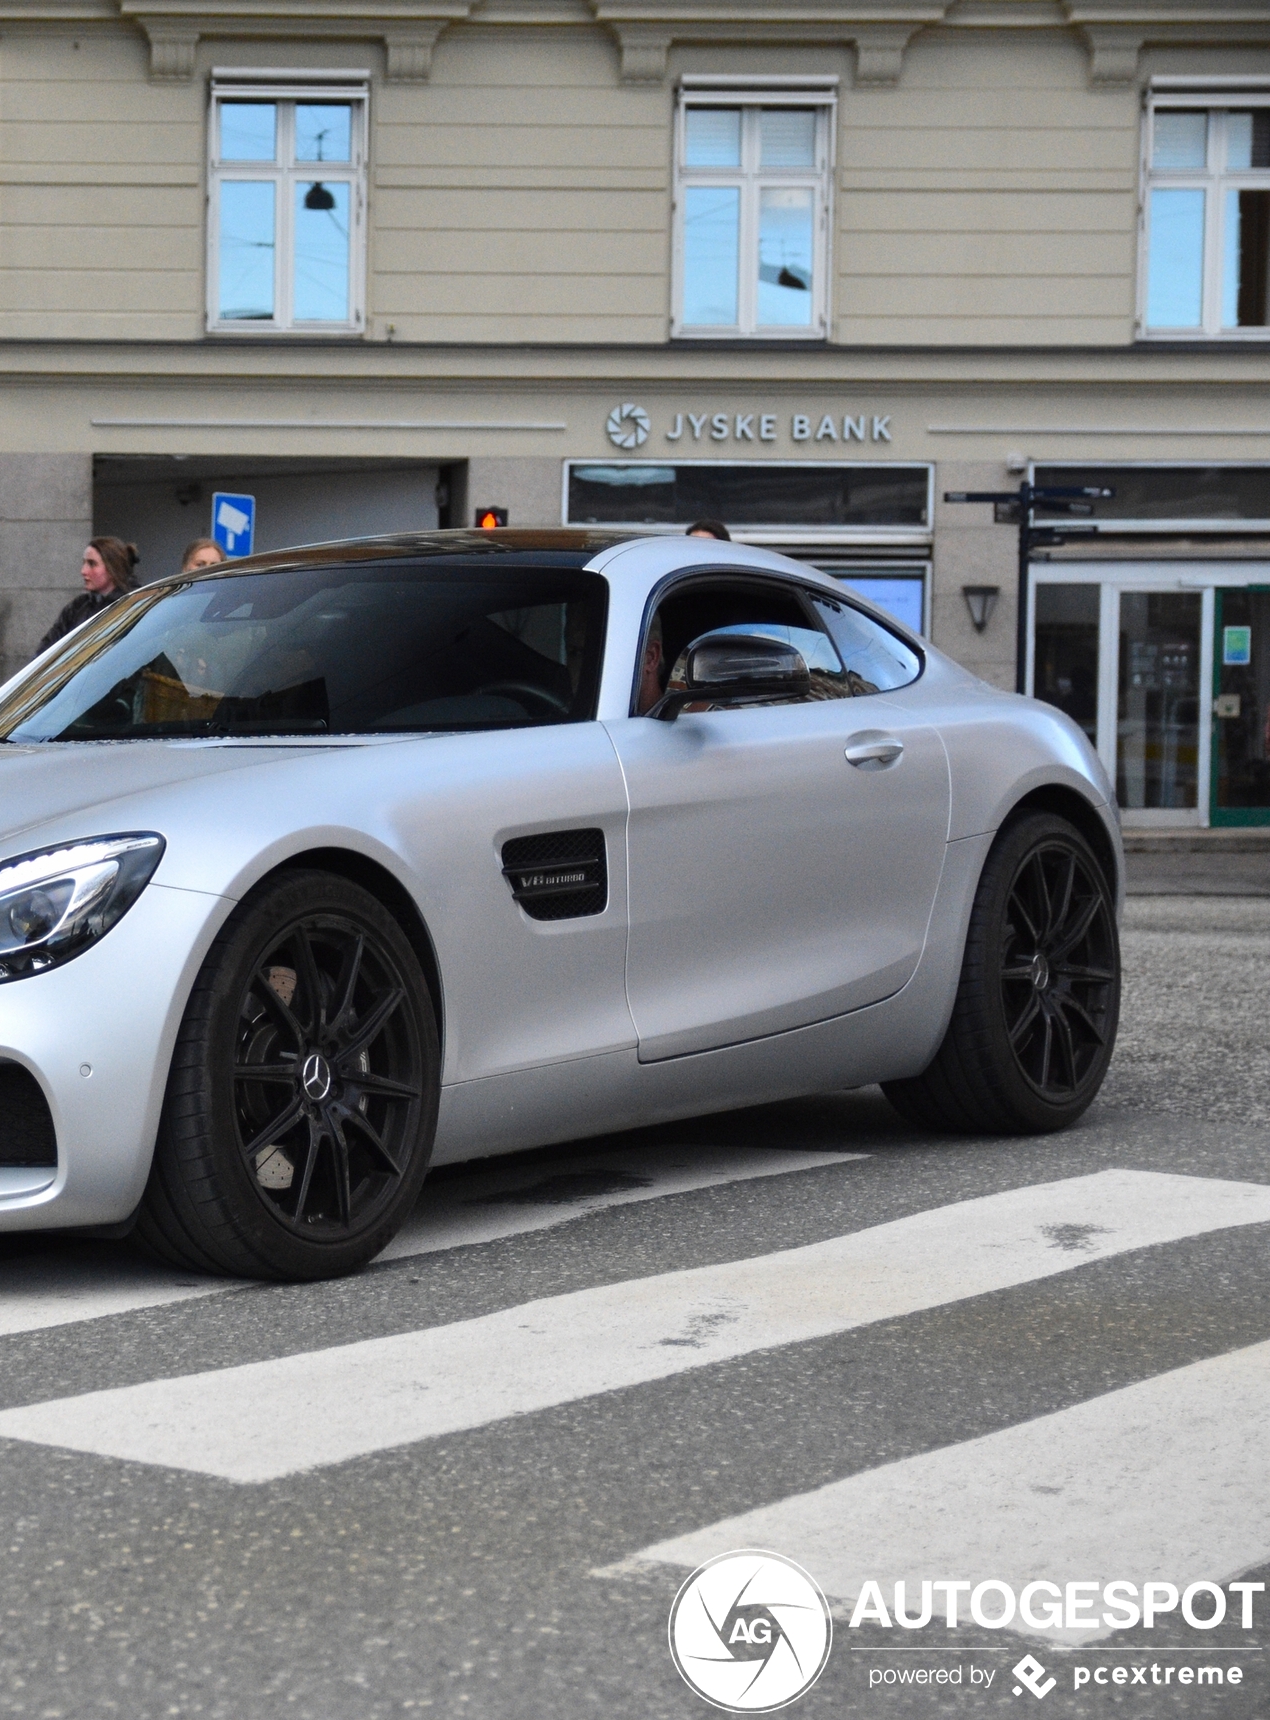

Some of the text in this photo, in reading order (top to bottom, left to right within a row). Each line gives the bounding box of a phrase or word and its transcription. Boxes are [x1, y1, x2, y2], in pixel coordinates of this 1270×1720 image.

[666, 413, 893, 442] JYSKE BANK
[520, 873, 585, 888] V8 BITURBO
